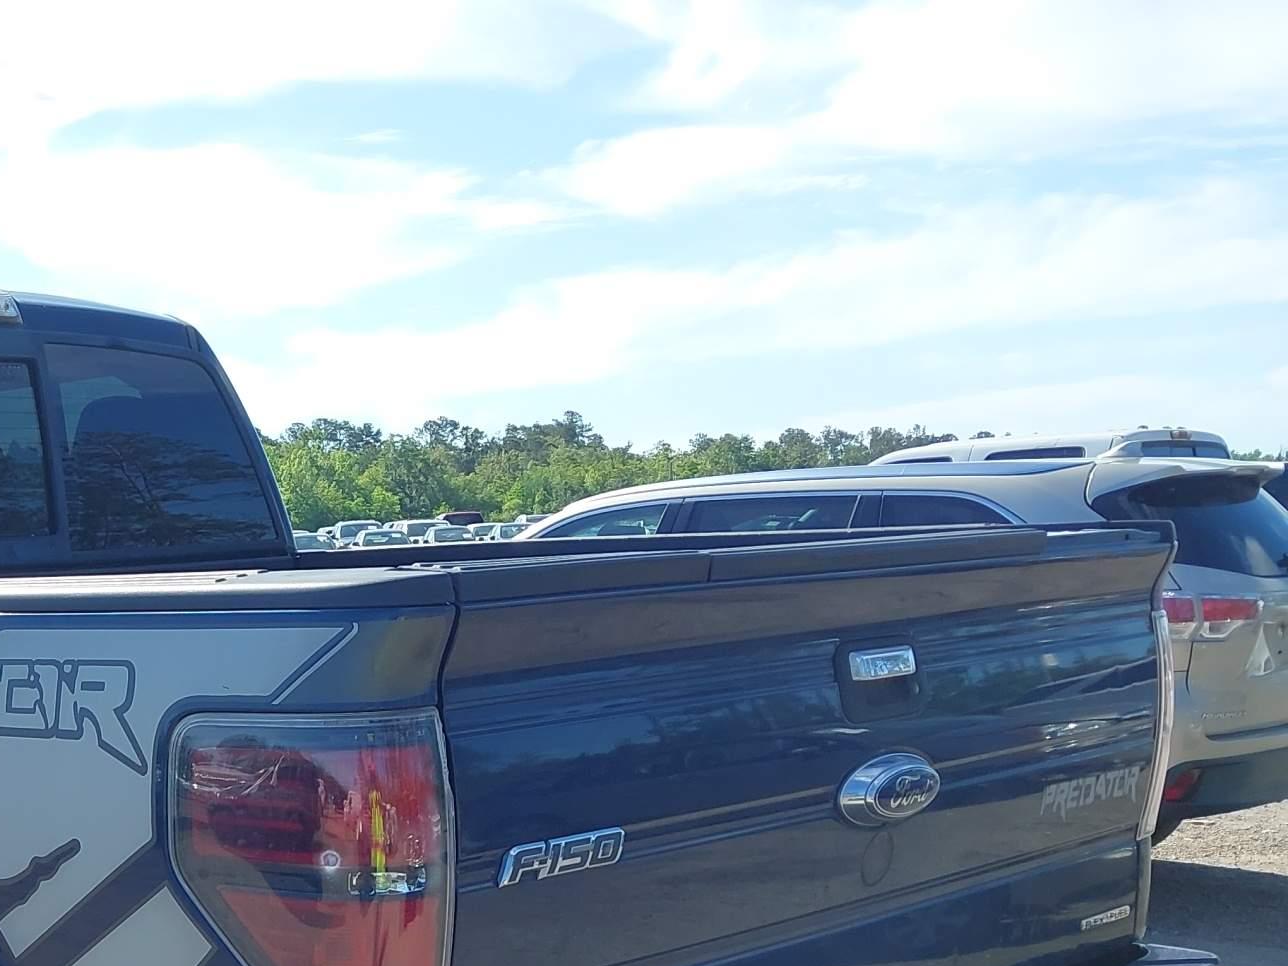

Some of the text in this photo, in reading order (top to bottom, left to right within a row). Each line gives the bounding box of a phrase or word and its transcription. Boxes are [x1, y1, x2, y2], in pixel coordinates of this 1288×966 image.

[890, 775, 933, 809] Ford
[1039, 765, 1141, 823] PREDATOR
[497, 827, 625, 888] F-150
